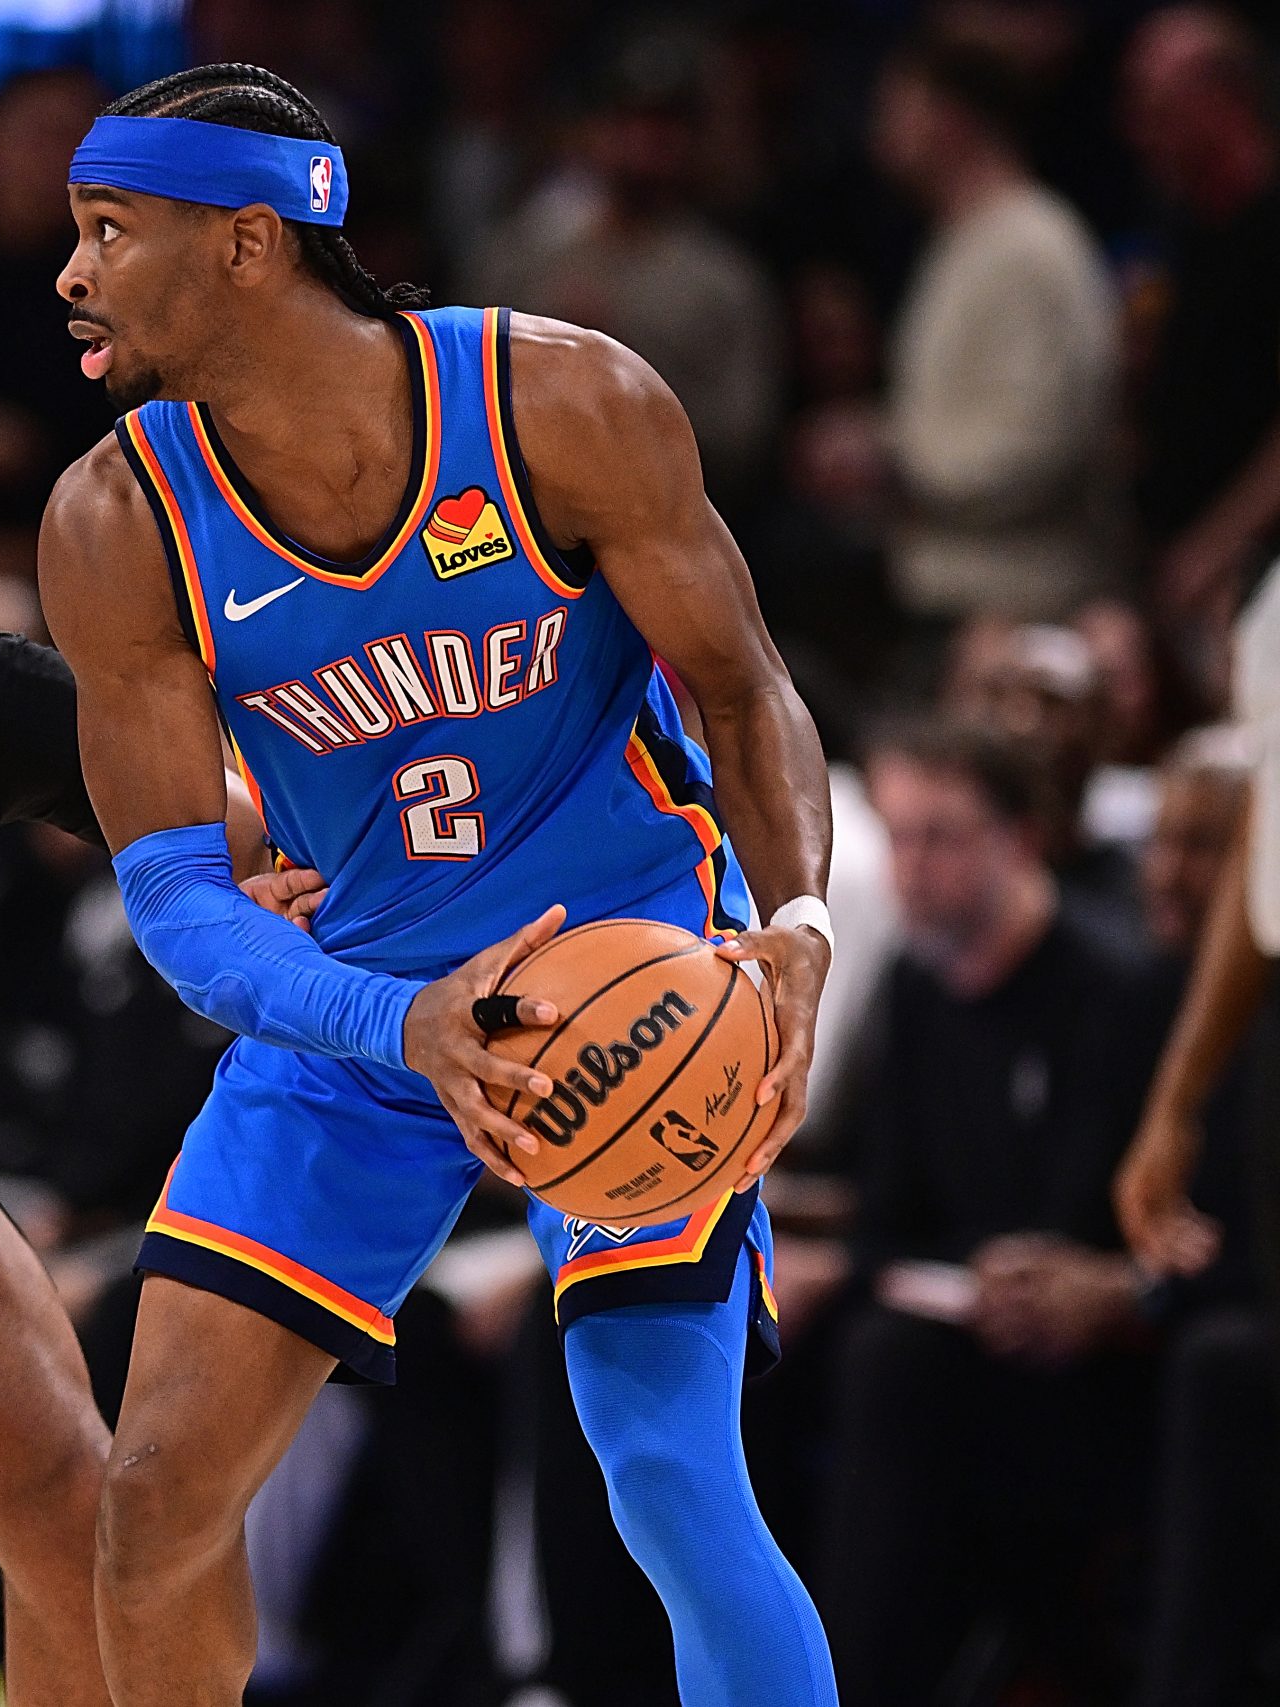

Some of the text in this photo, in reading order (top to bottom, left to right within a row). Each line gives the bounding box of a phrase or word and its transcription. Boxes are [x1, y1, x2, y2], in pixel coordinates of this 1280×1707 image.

[235, 606, 568, 756] THUNDER
[391, 754, 486, 862] 2
[523, 989, 698, 1147] Wilson
